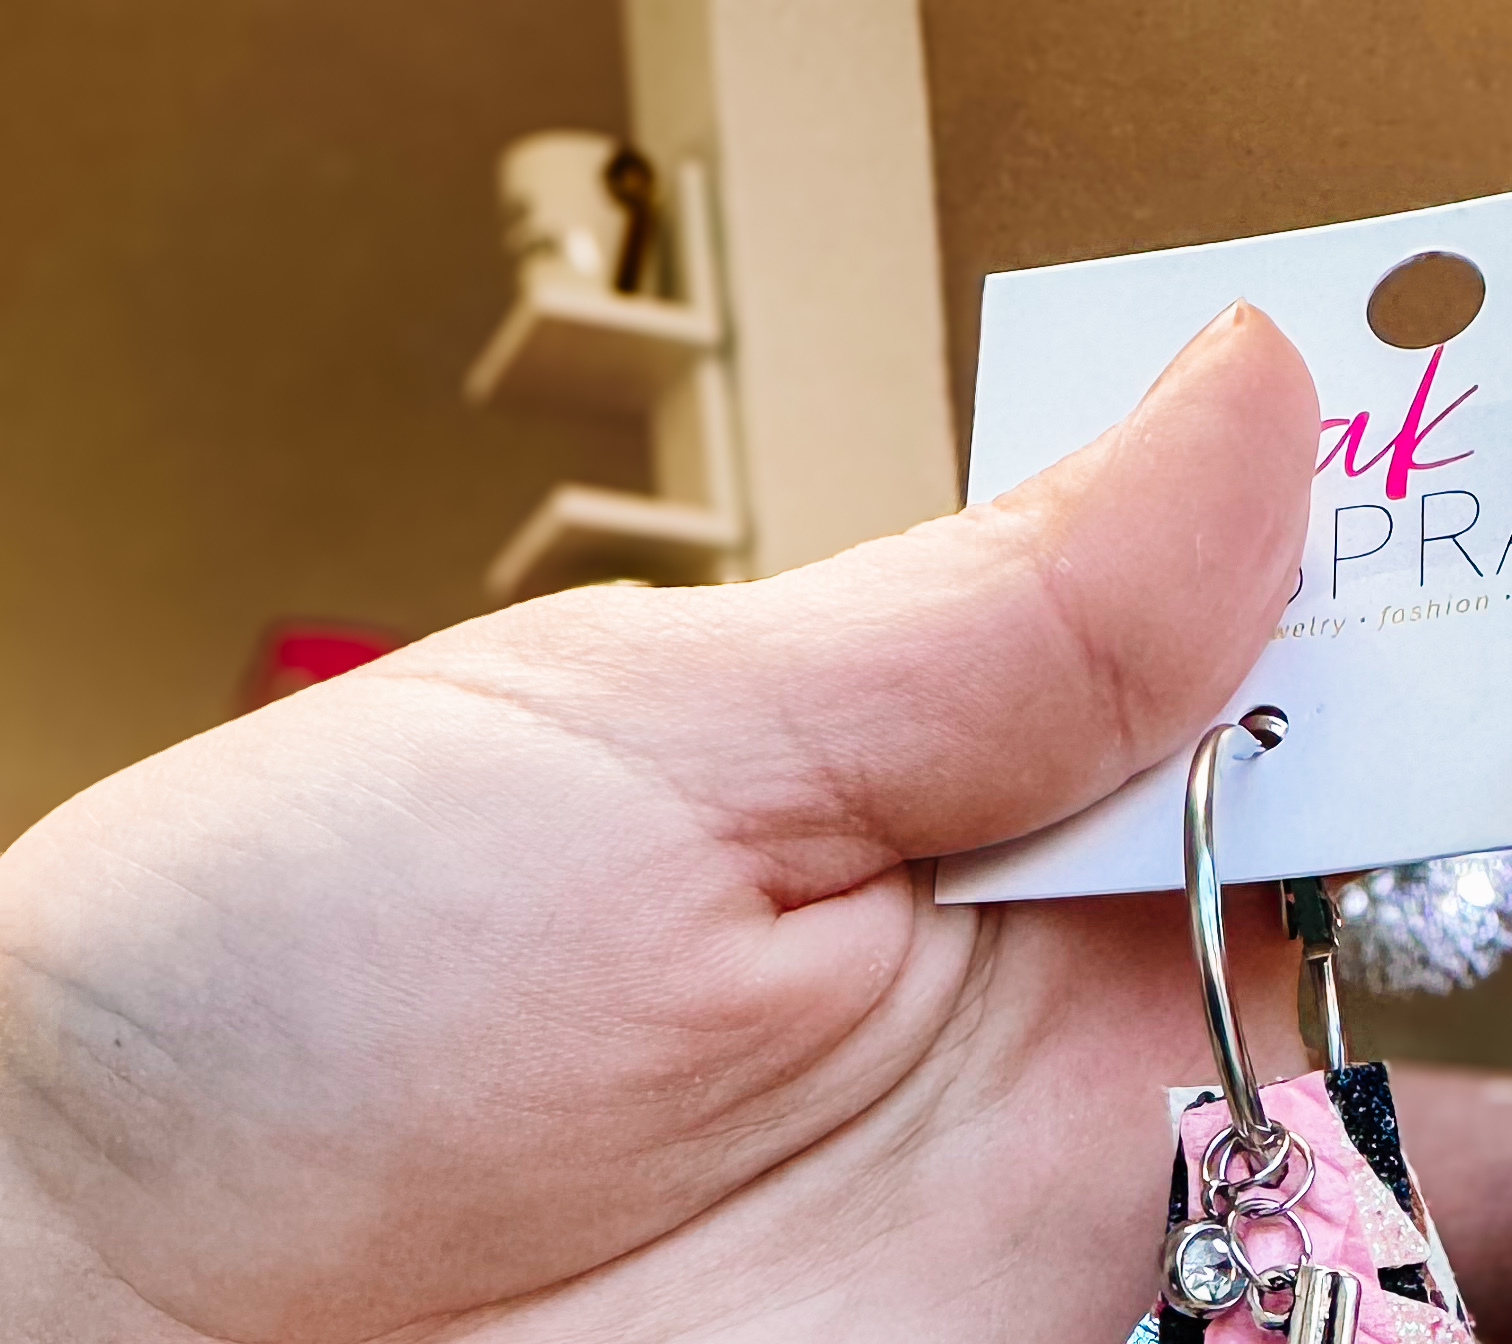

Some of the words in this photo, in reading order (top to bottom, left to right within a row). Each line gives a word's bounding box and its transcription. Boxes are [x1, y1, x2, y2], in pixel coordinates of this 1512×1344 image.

[1313, 343, 1479, 500] ak
[1272, 615, 1347, 639] welry
[1378, 593, 1490, 631] fashion
